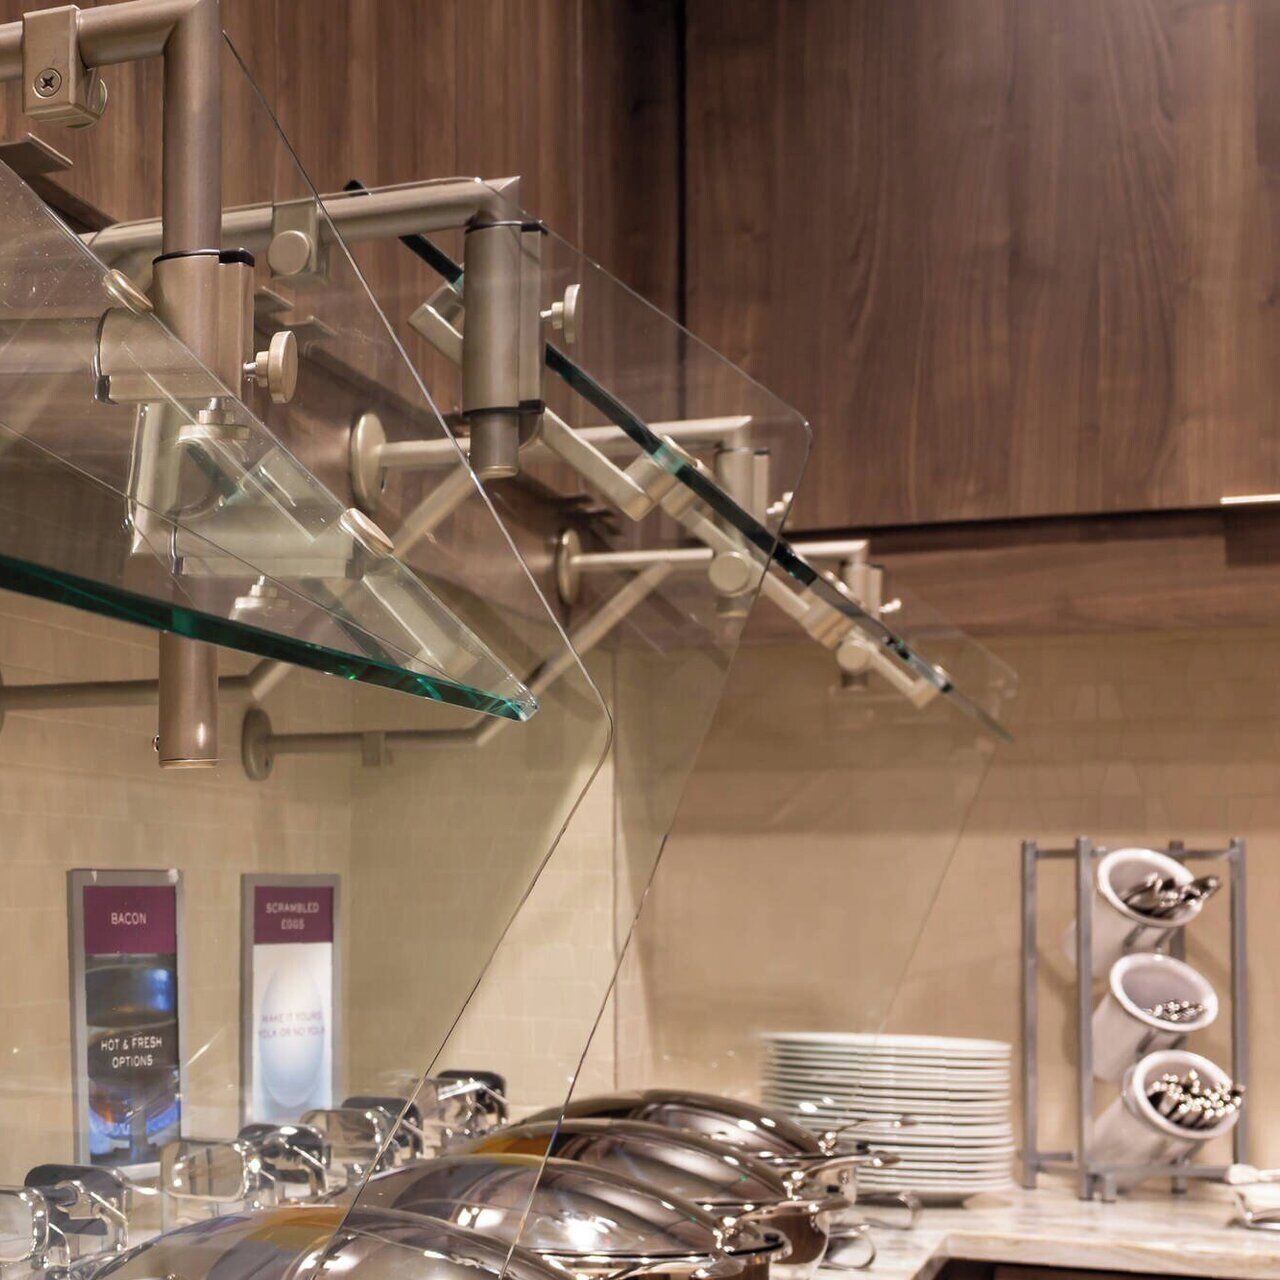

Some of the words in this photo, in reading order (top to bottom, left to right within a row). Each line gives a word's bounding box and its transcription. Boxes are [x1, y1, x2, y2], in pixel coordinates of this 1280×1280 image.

[111, 912, 147, 925] BACON
[101, 1038, 119, 1051] HOT
[123, 1040, 129, 1050] &
[132, 1036, 162, 1049] FRESH
[112, 1054, 153, 1068] OPTIONS
